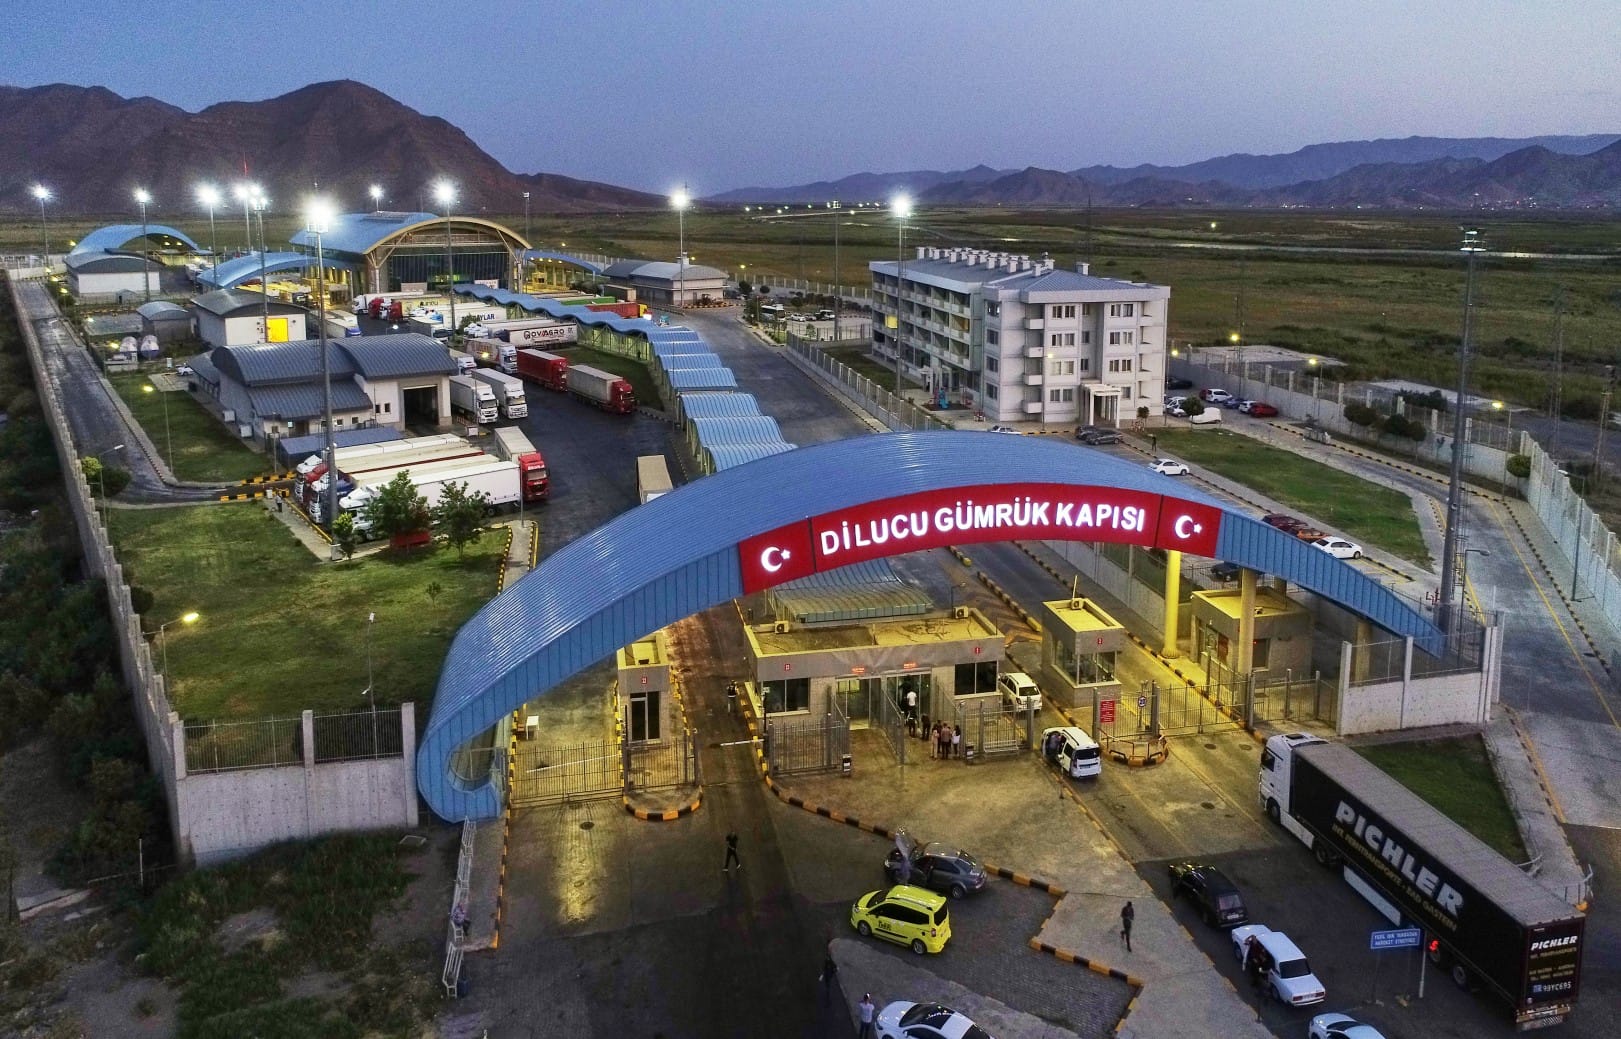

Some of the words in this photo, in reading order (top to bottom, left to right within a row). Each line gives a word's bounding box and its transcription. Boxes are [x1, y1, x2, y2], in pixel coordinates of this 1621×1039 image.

[820, 511, 928, 556] DİLUCU
[934, 496, 1050, 532] GÜMRÜK
[1055, 502, 1146, 533] KAPISI
[1335, 800, 1464, 919] PICHLER
[1530, 935, 1578, 951] PICHLER
